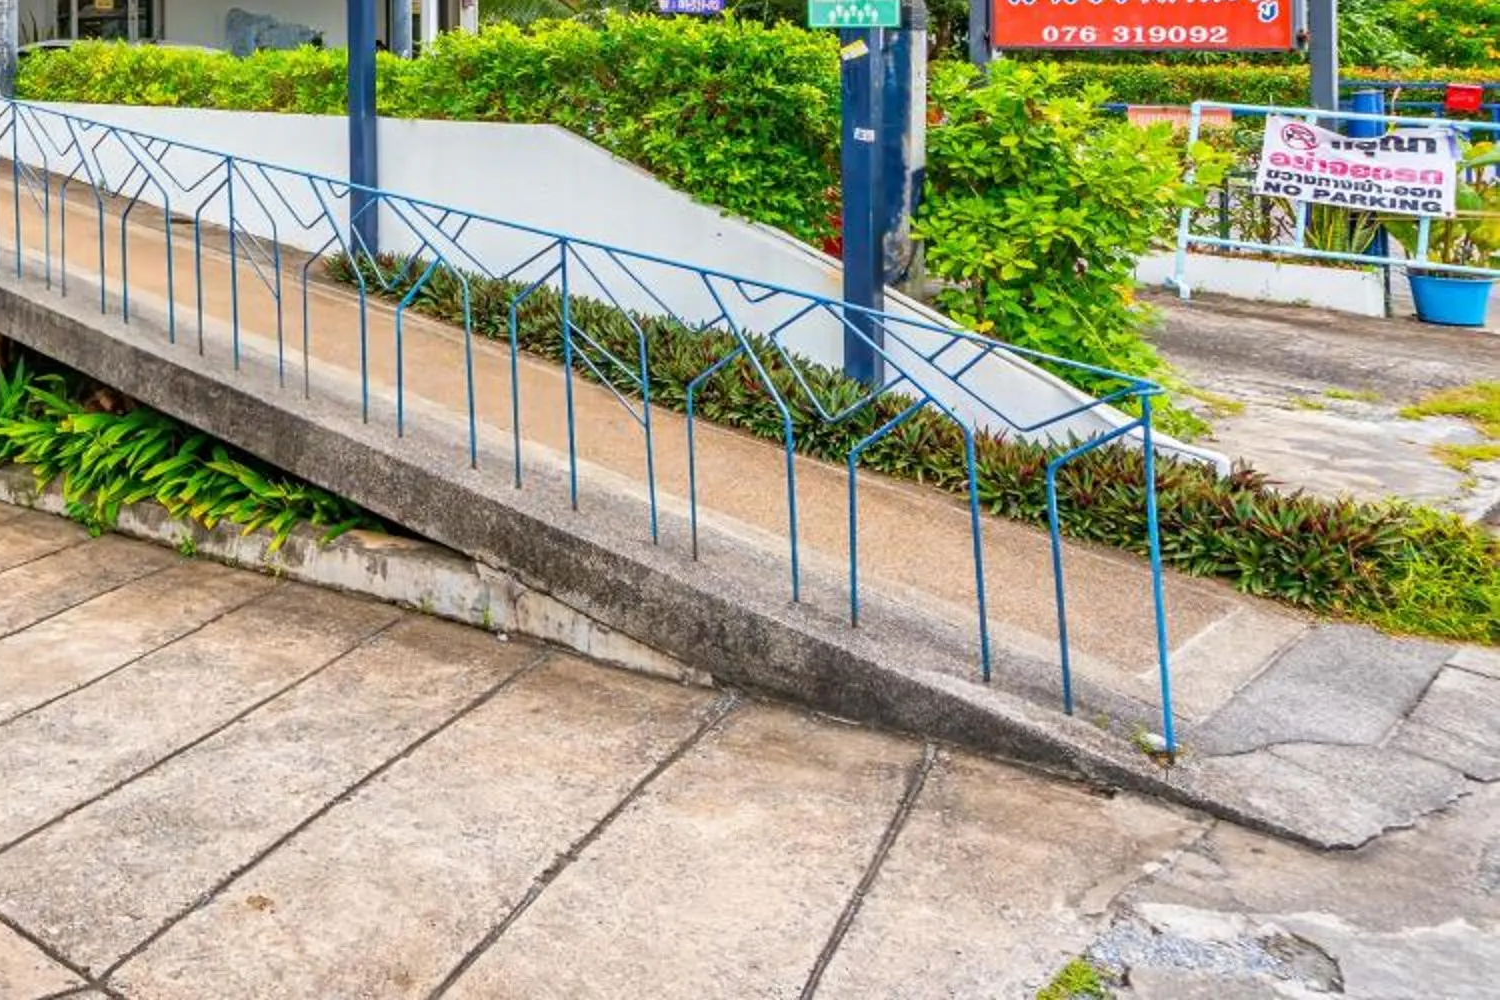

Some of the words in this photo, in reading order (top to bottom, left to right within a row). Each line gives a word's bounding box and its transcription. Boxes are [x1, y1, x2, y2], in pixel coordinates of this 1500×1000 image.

[1041, 25, 1098, 44] 076
[1112, 24, 1230, 44] 319092
[1269, 151, 1443, 185] อย่าจอดรถ
[1263, 181, 1302, 197] NO
[1312, 188, 1443, 213] PARKING
